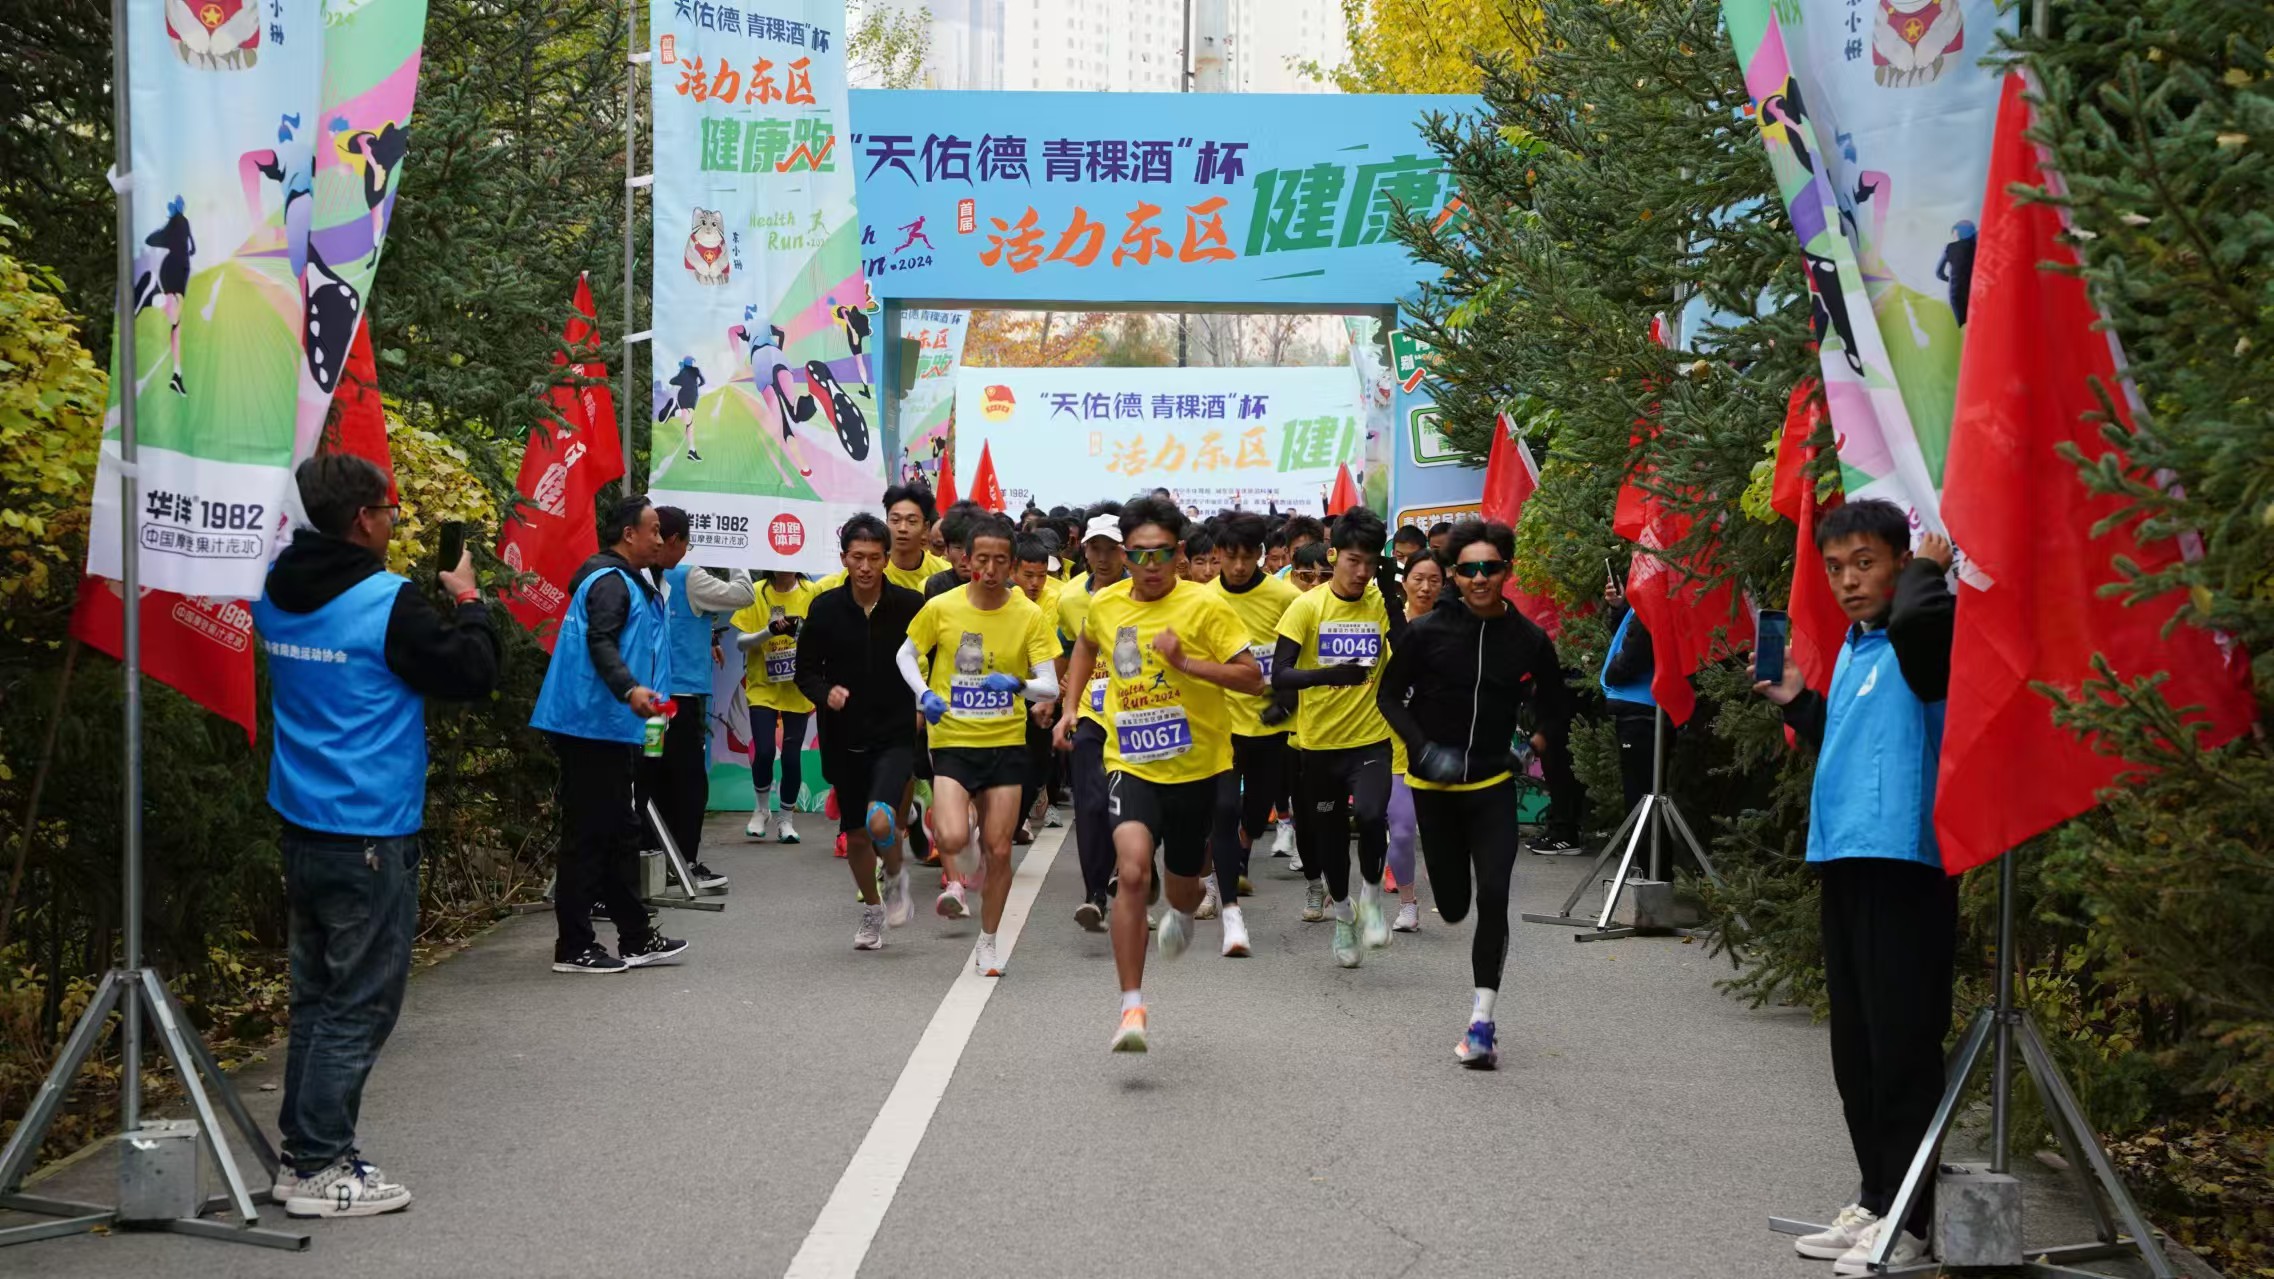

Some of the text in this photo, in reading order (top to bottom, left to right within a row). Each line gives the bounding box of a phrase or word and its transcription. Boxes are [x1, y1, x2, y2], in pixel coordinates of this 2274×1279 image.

[675, 56, 816, 105] 活力东区
[700, 116, 836, 173] 健康跑
[751, 211, 795, 229] Health
[959, 202, 974, 231] 首届
[768, 231, 804, 250] Run
[978, 196, 1237, 273] 活力东区
[1106, 426, 1272, 476] 活力东区
[201, 501, 264, 530] 1982
[715, 517, 748, 532] 1982
[772, 521, 801, 534] 劲跑
[774, 534, 802, 546] 体育
[1332, 637, 1378, 654] 0046
[963, 690, 1009, 708] 0253
[1123, 695, 1149, 711] Run
[1130, 723, 1182, 751] 0067
